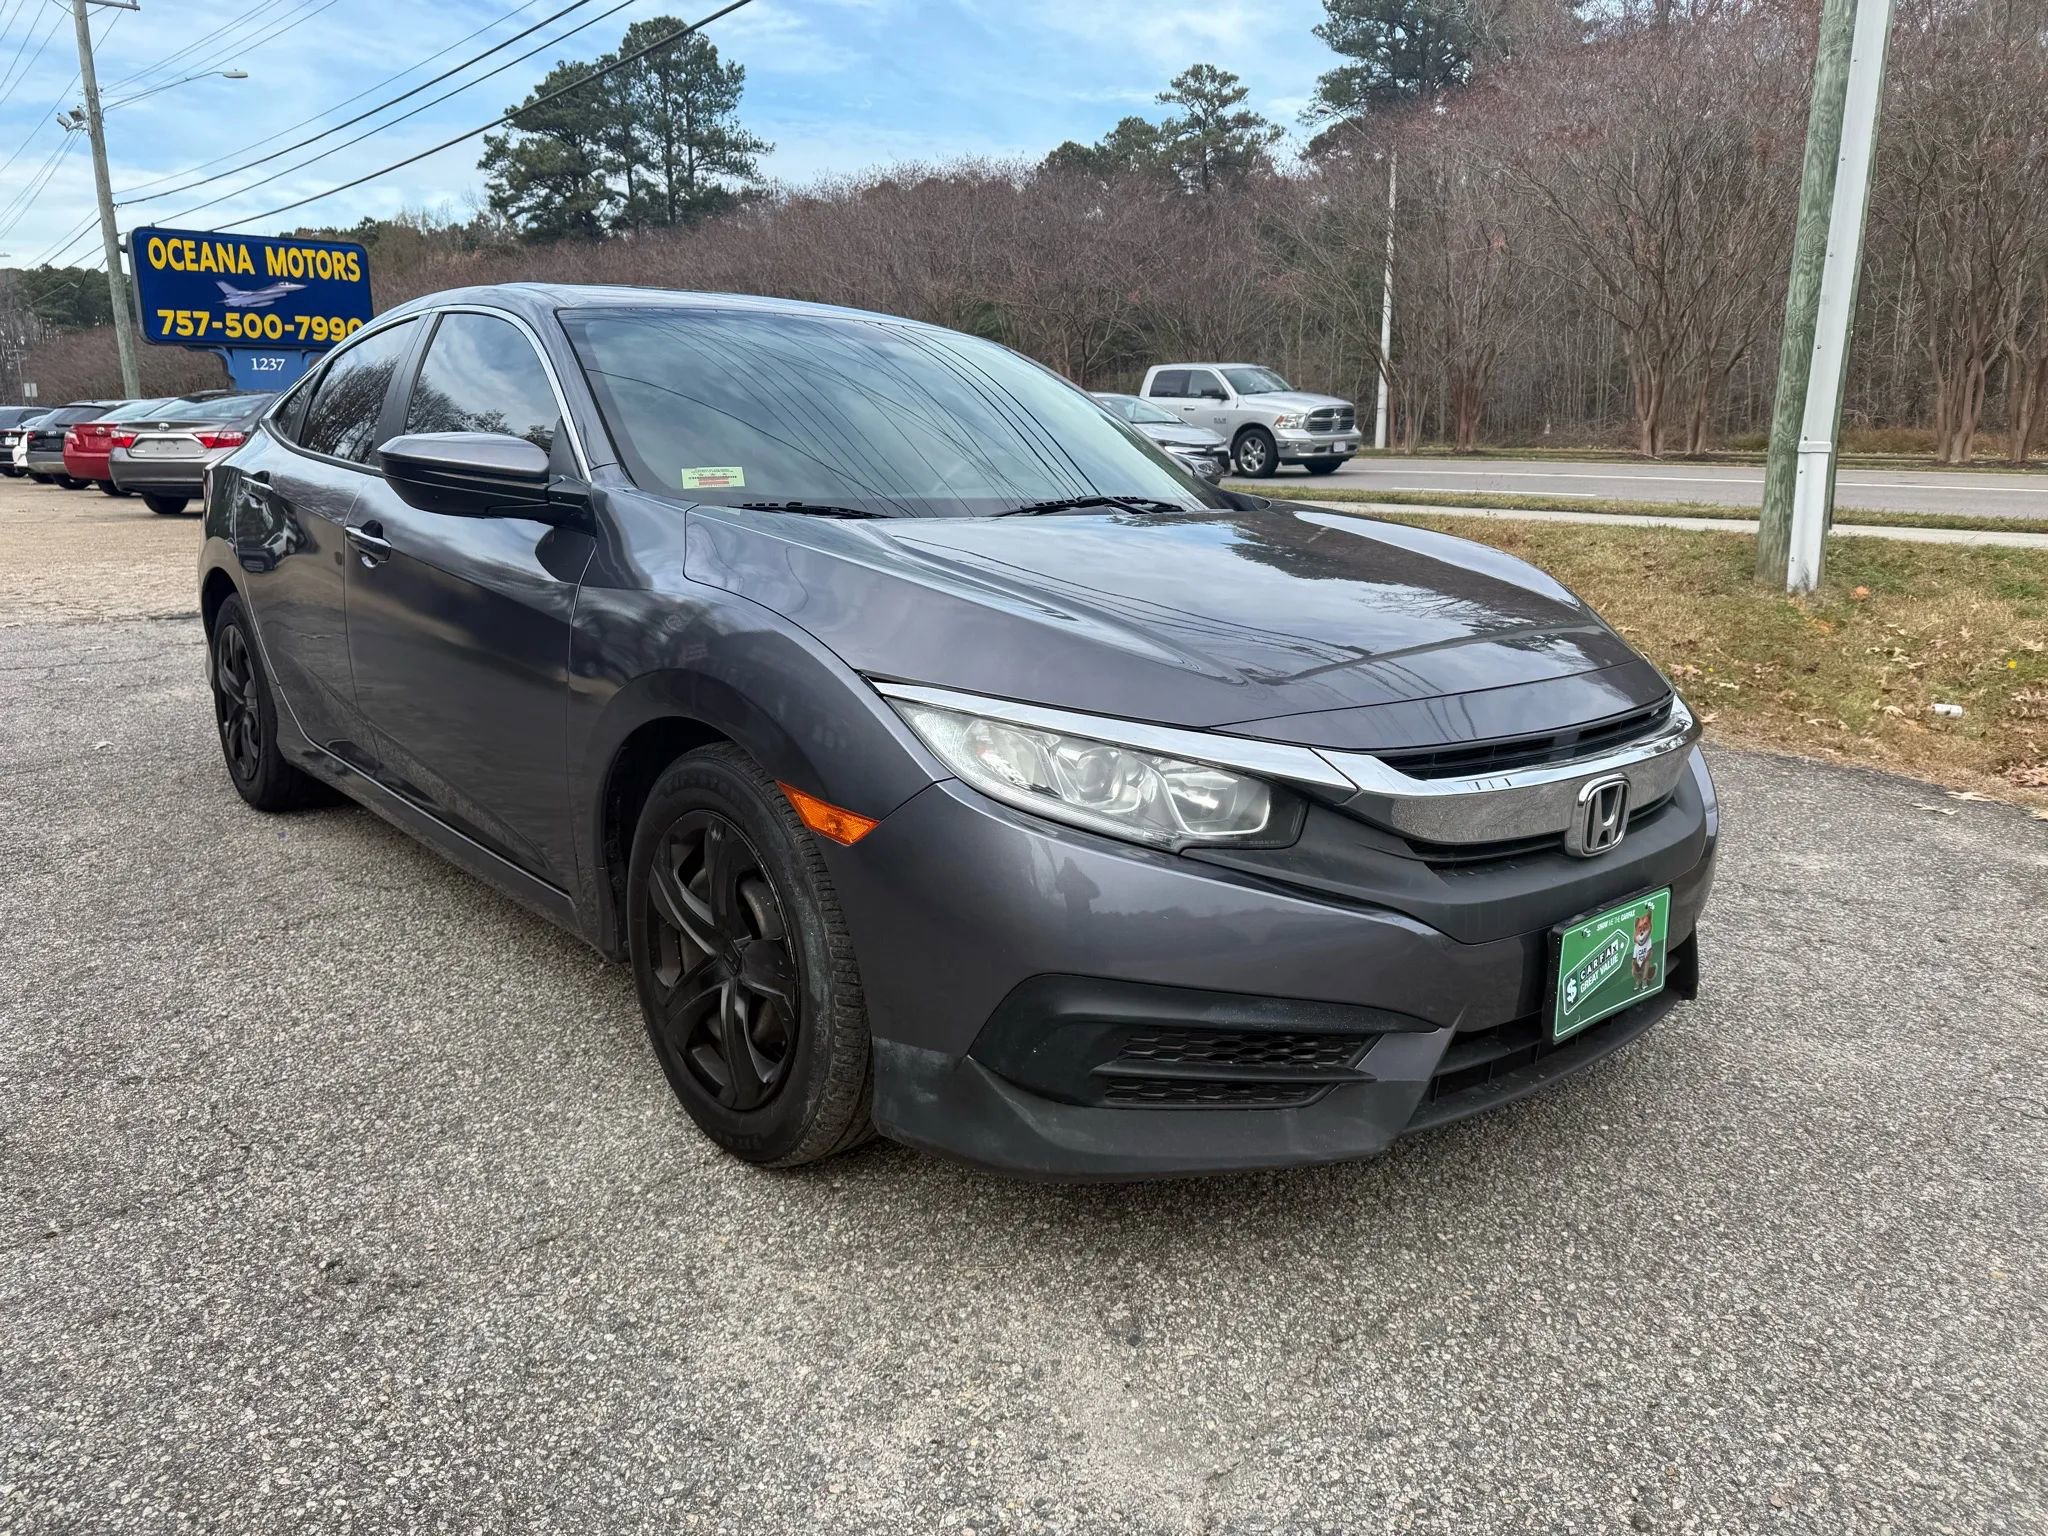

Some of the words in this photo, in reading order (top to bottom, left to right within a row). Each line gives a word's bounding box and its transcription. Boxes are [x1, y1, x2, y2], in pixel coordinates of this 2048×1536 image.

[147, 237, 256, 275] OCEANA
[265, 246, 362, 283] MOTORS
[157, 309, 363, 342] 757-500-7990
[250, 357, 286, 372] 1237
[1580, 972, 1600, 993] GREAT
[1599, 953, 1619, 976] VALUE
